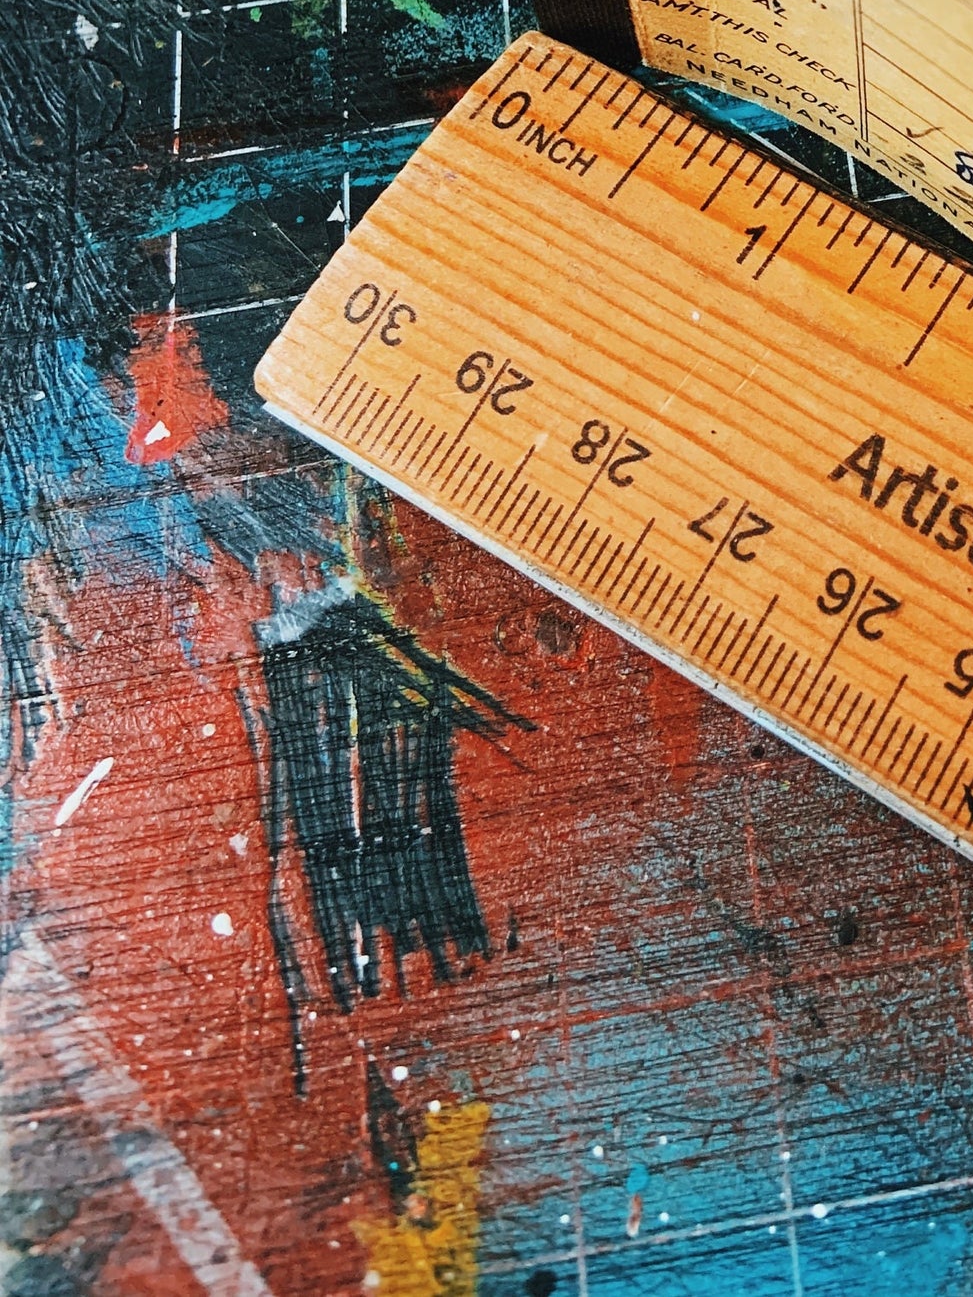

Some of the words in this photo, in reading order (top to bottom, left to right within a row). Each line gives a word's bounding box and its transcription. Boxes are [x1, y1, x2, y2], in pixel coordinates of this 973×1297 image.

[776, 42, 857, 91] CHECK
[686, 60, 837, 135] NEEDHAM
[516, 119, 599, 177] INCH
[736, 224, 768, 264] 1
